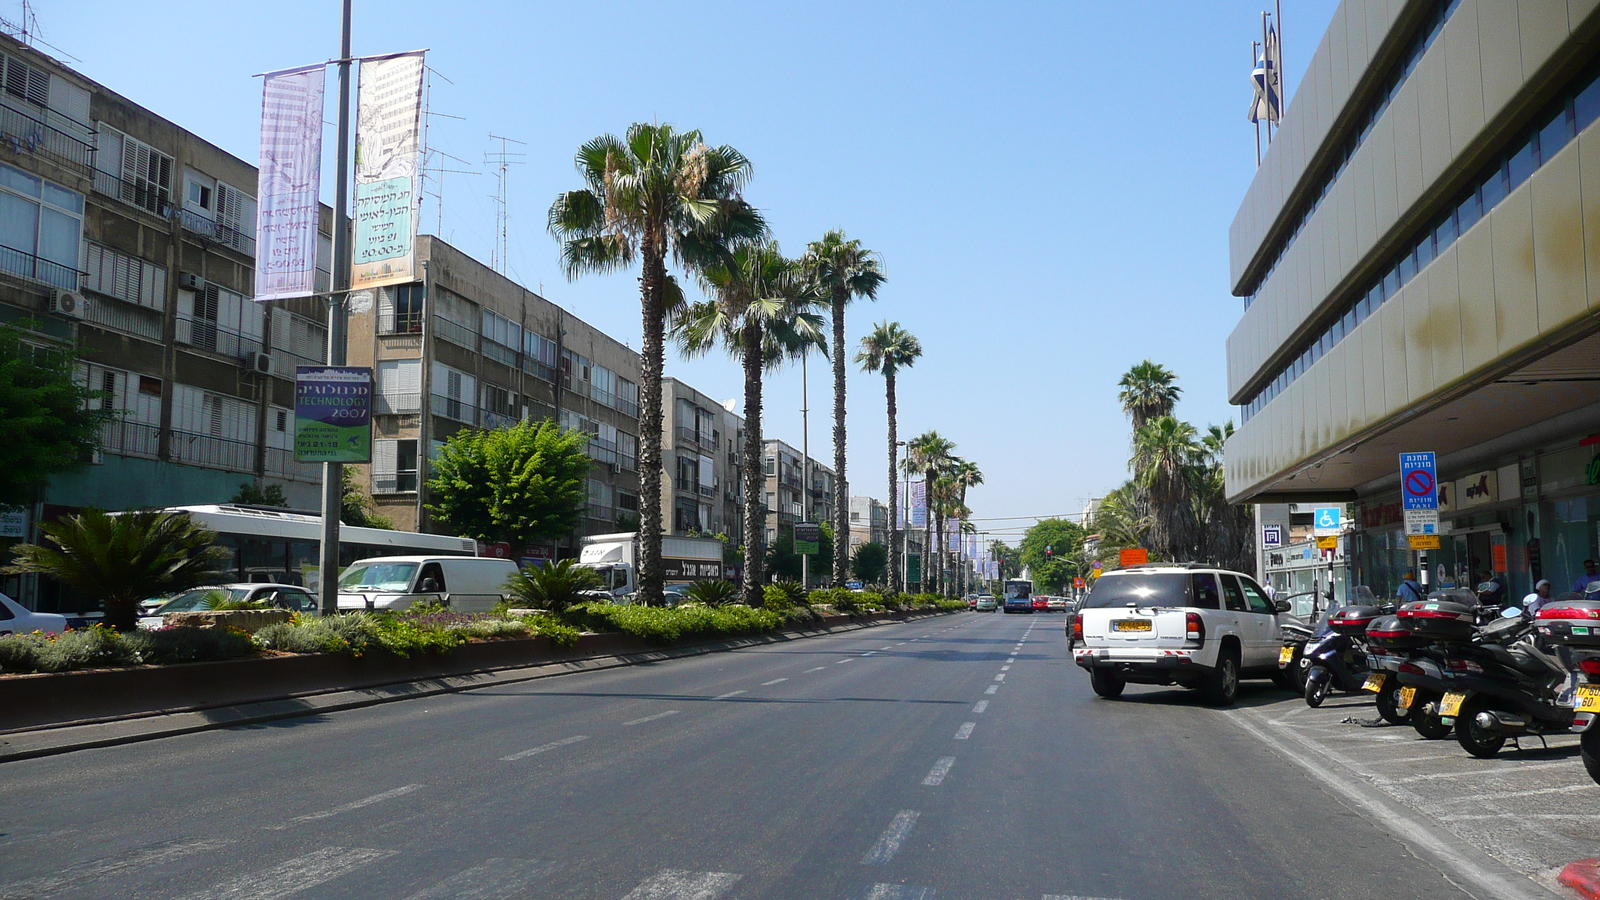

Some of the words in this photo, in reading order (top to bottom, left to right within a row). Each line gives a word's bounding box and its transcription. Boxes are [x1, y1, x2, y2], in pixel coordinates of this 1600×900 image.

[398, 190, 411, 200] חג
[357, 192, 397, 208] המוסיקה
[298, 384, 368, 395] טכנולוגיה
[299, 397, 366, 406] TECHNOLOGY
[332, 409, 366, 418] 2007
[1406, 454, 1428, 462] תחנת
